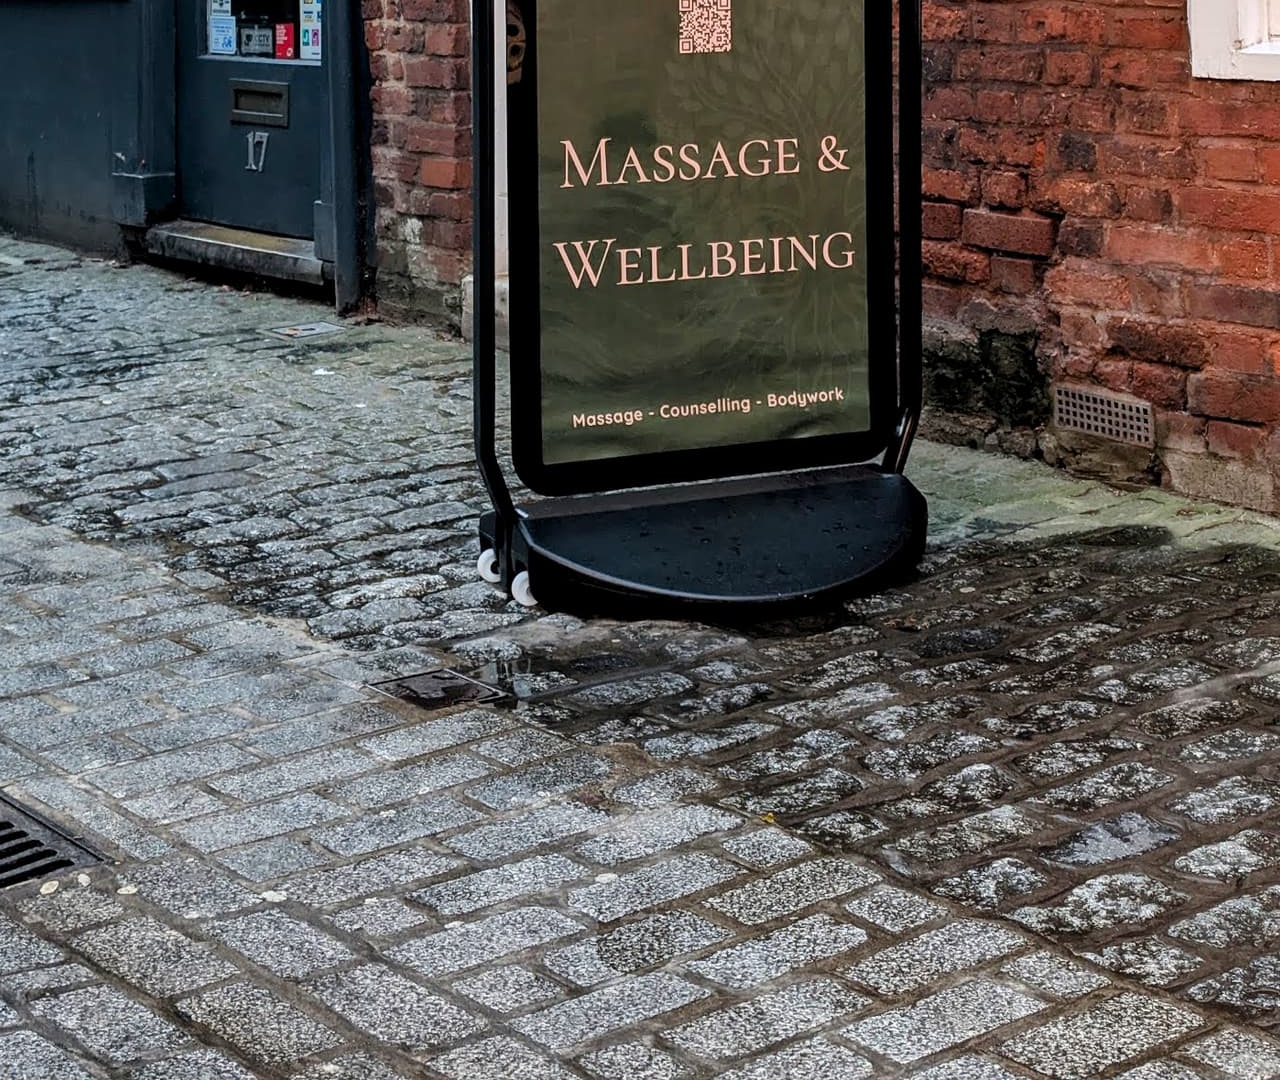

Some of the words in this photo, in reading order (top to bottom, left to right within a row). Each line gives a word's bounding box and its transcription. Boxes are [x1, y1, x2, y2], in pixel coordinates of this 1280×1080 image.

[245, 130, 269, 172] 17
[559, 136, 801, 189] MASSAGE
[817, 134, 851, 172] &
[552, 232, 857, 289] WELLBEING
[572, 407, 644, 429] Massage
[660, 398, 751, 419] Counselling
[767, 387, 845, 409] Bodywork
